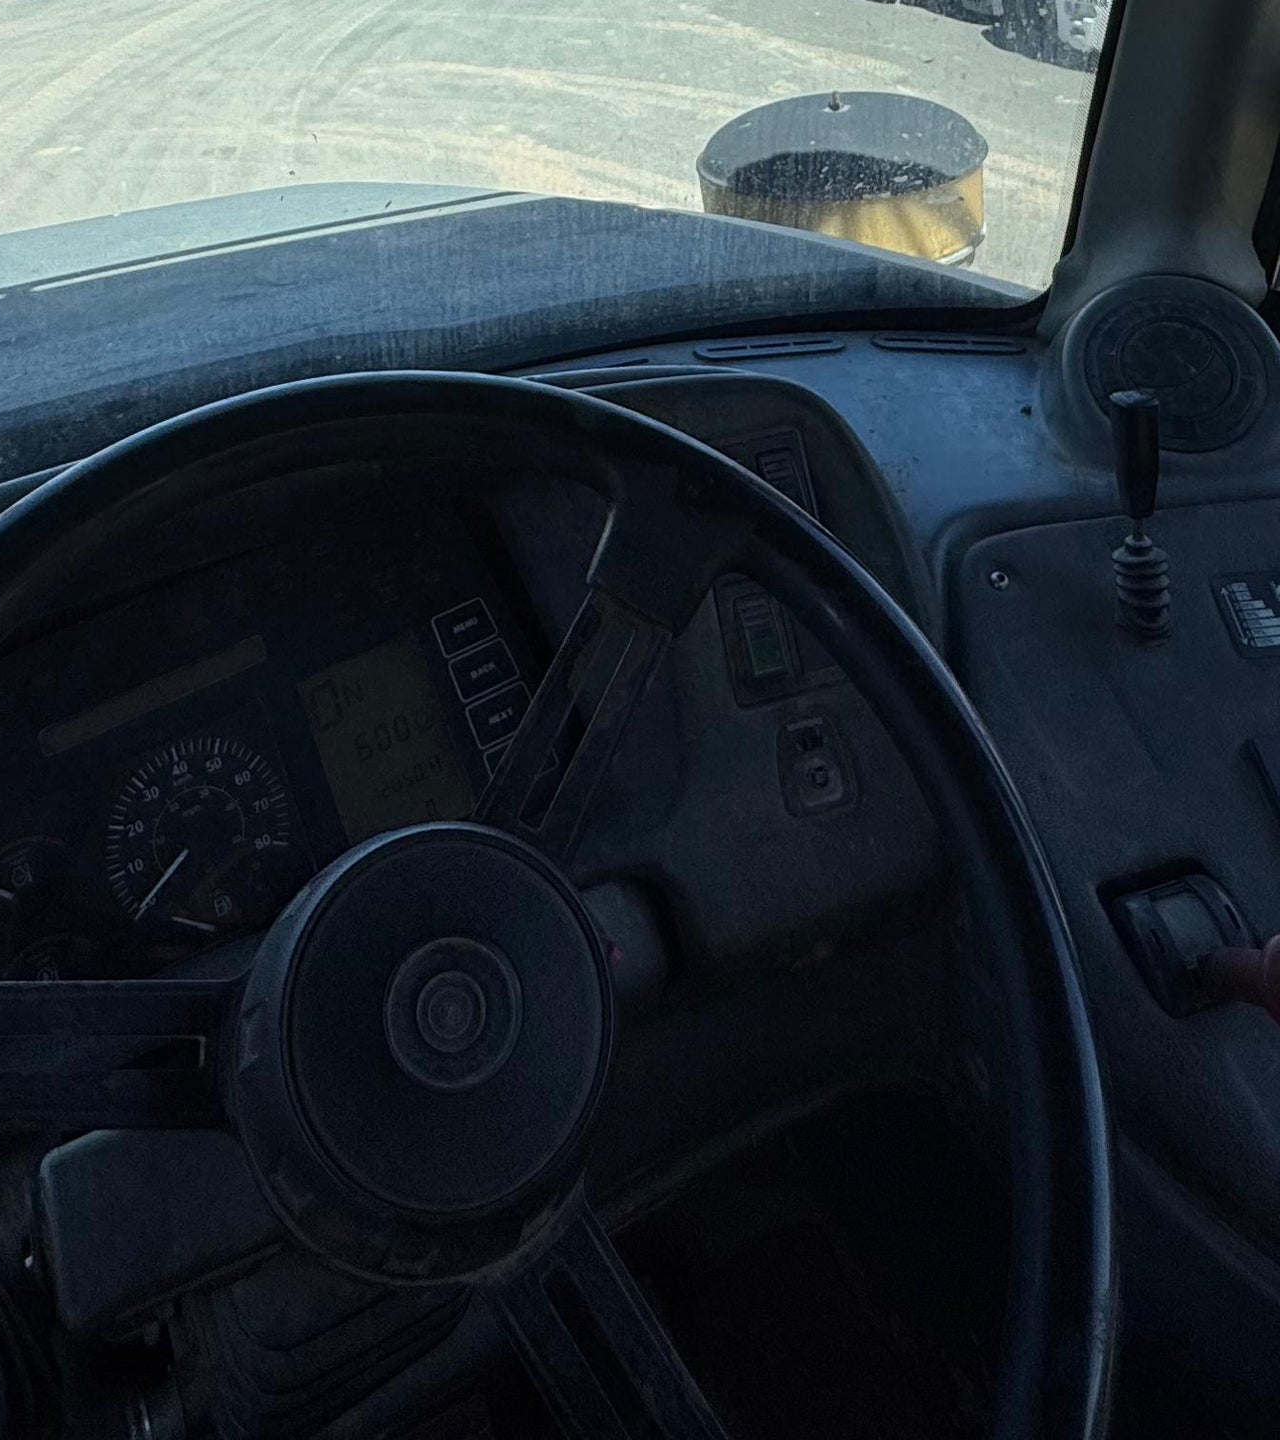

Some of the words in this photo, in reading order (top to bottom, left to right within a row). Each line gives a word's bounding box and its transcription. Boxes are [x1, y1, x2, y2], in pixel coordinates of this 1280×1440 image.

[171, 760, 189, 776] 40
[204, 757, 223, 773] 50
[233, 769, 252, 787] 60
[142, 785, 161, 803] 30
[251, 797, 270, 813] 70
[126, 819, 145, 837] 20
[254, 833, 272, 850] 80
[127, 858, 145, 874] 10
